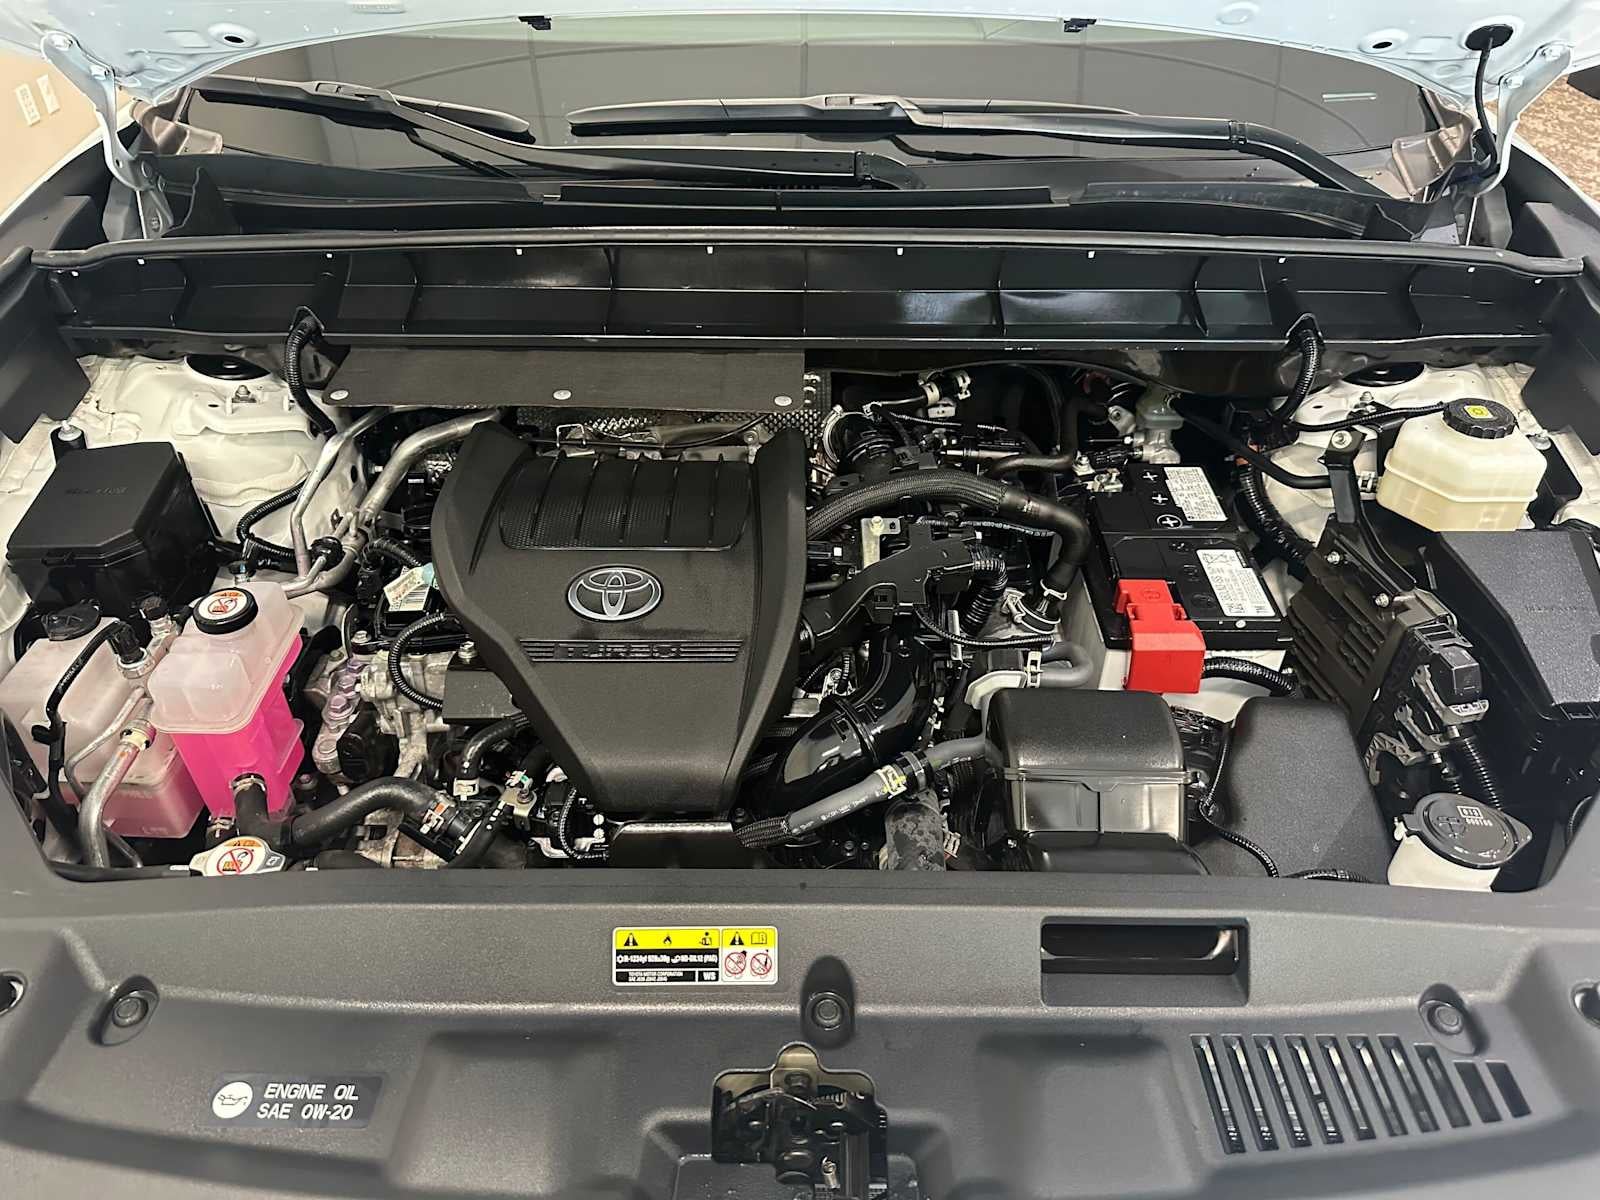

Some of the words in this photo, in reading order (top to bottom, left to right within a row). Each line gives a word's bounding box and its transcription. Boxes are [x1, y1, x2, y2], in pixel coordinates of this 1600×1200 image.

[558, 641, 679, 658] TURBO
[703, 972, 717, 981] WS
[263, 1083, 327, 1100] ENGINE
[333, 1084, 359, 1101] OIL
[256, 1102, 294, 1119] SAE
[301, 1103, 354, 1121] 0W-20
